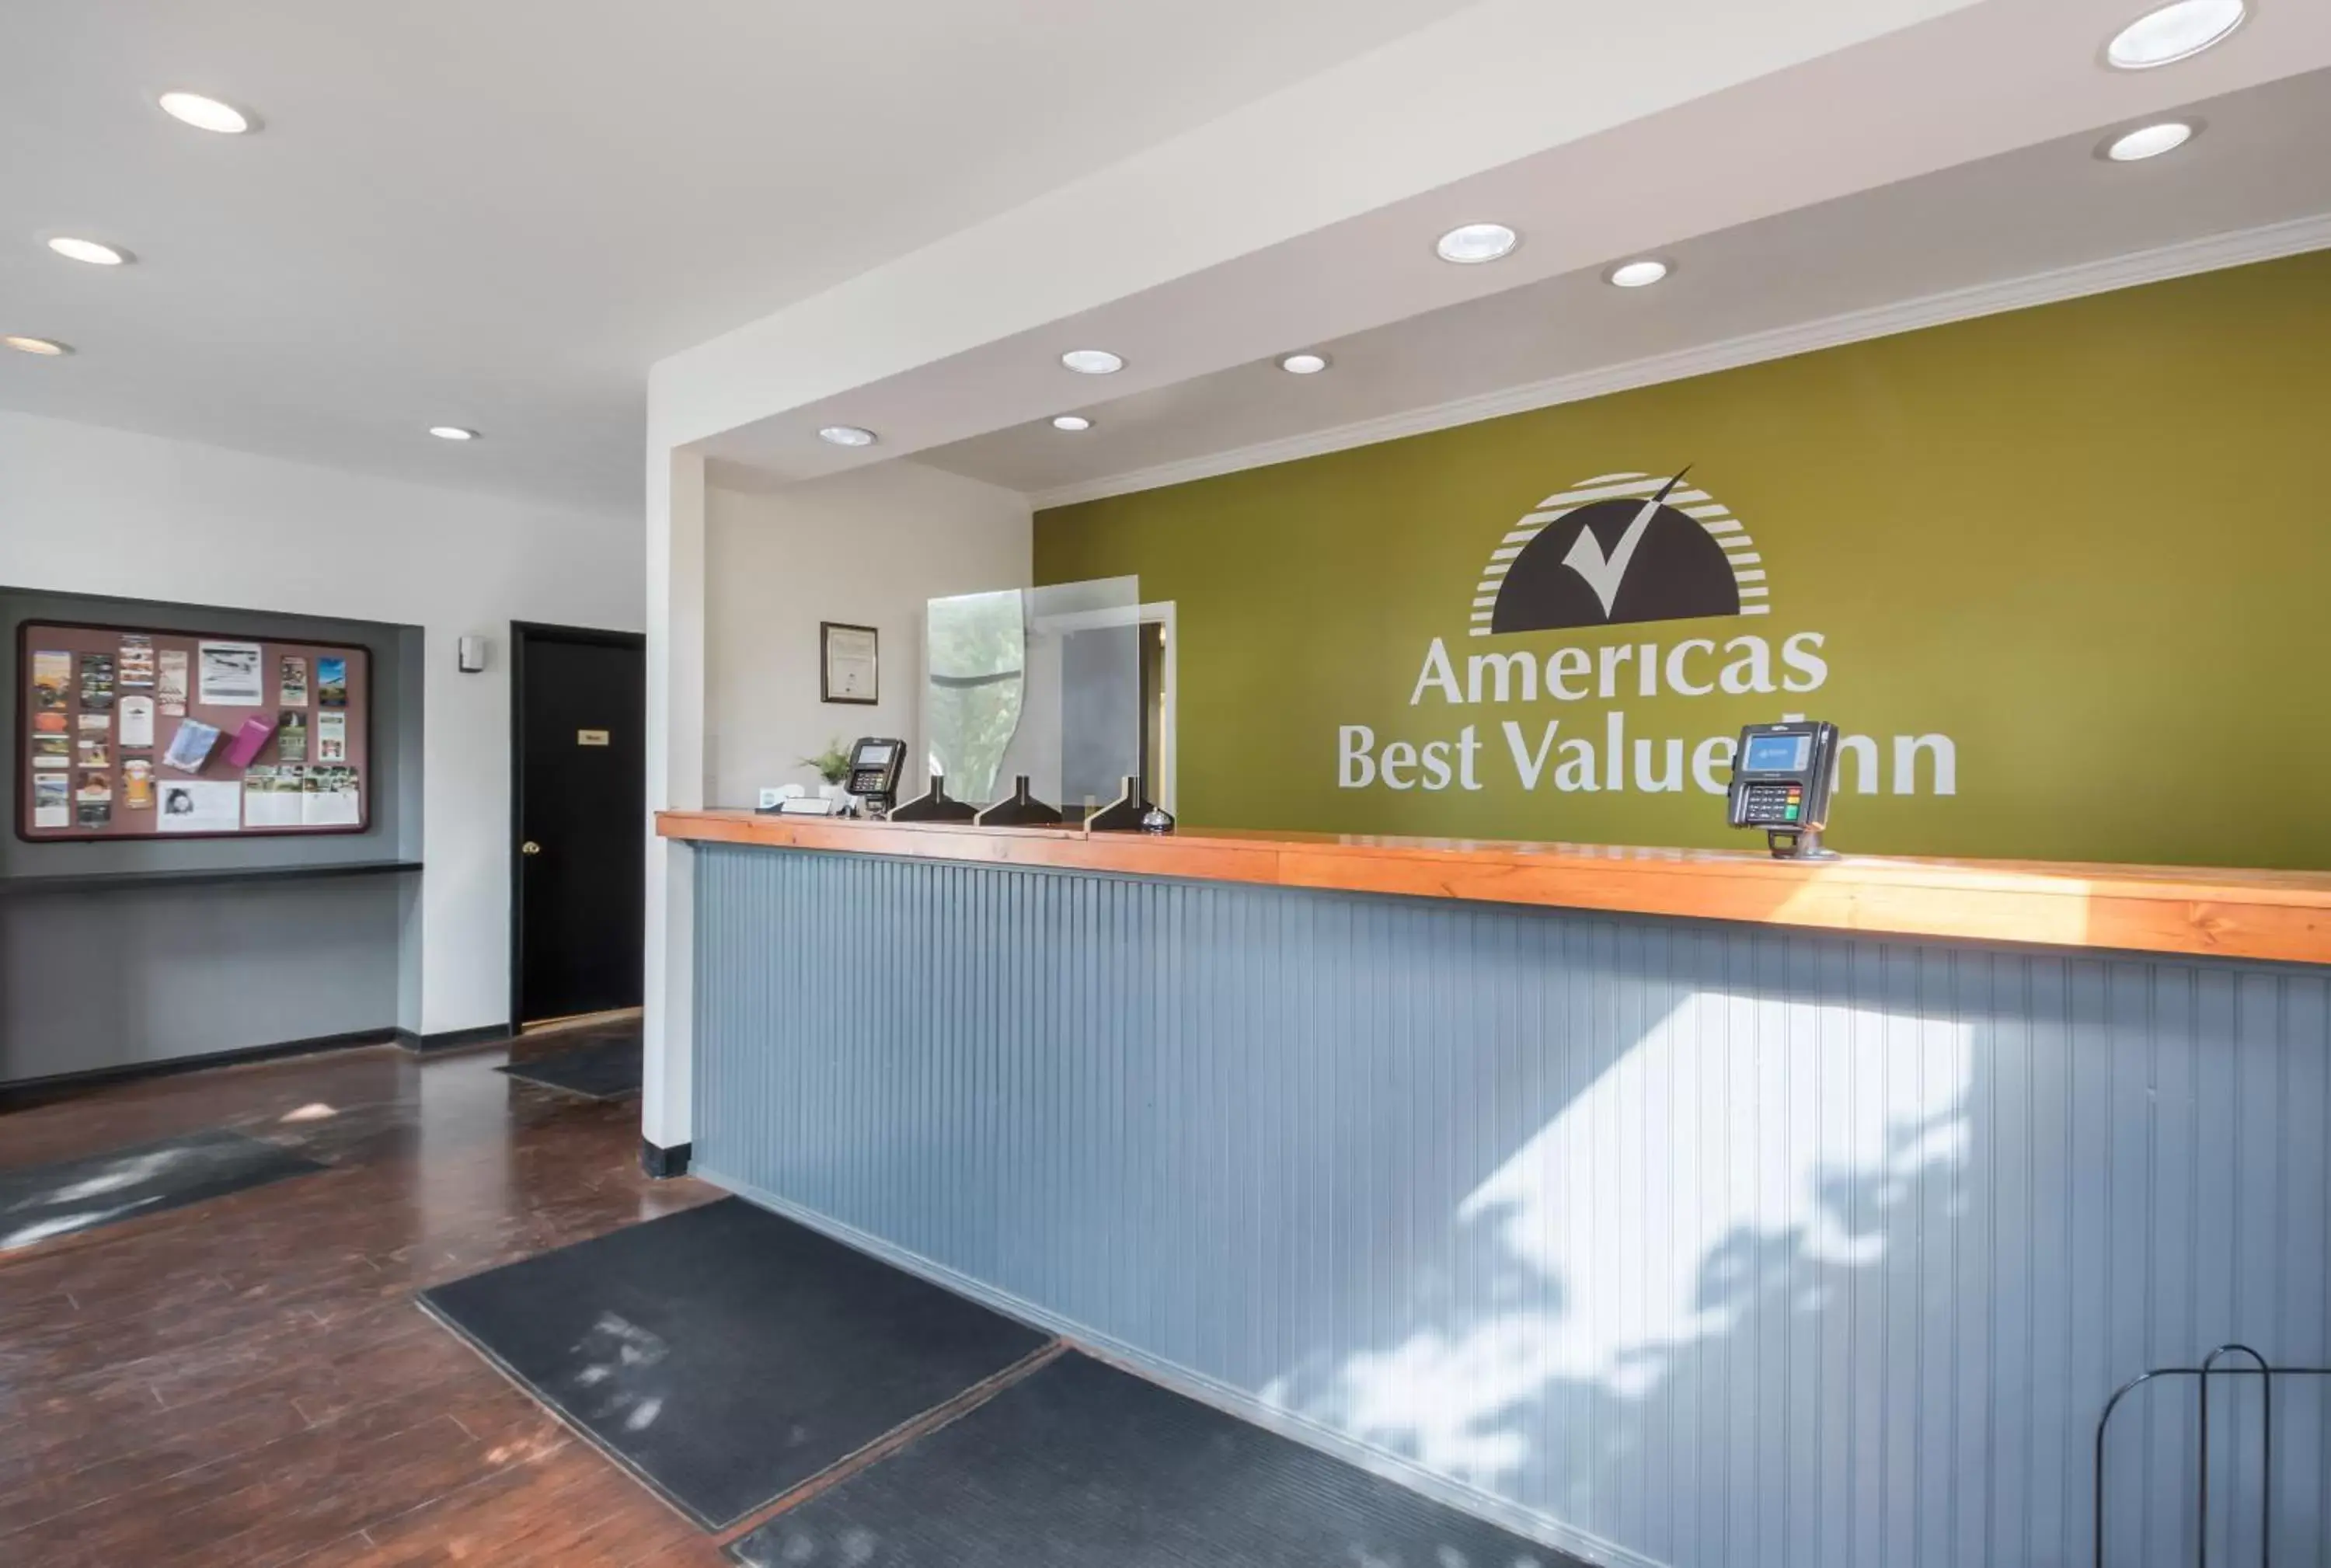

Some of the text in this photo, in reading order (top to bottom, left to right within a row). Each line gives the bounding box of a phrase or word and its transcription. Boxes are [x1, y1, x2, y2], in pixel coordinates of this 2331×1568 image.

[1409, 632, 1828, 706] Americas
[1338, 711, 1957, 796] Best Value nn
